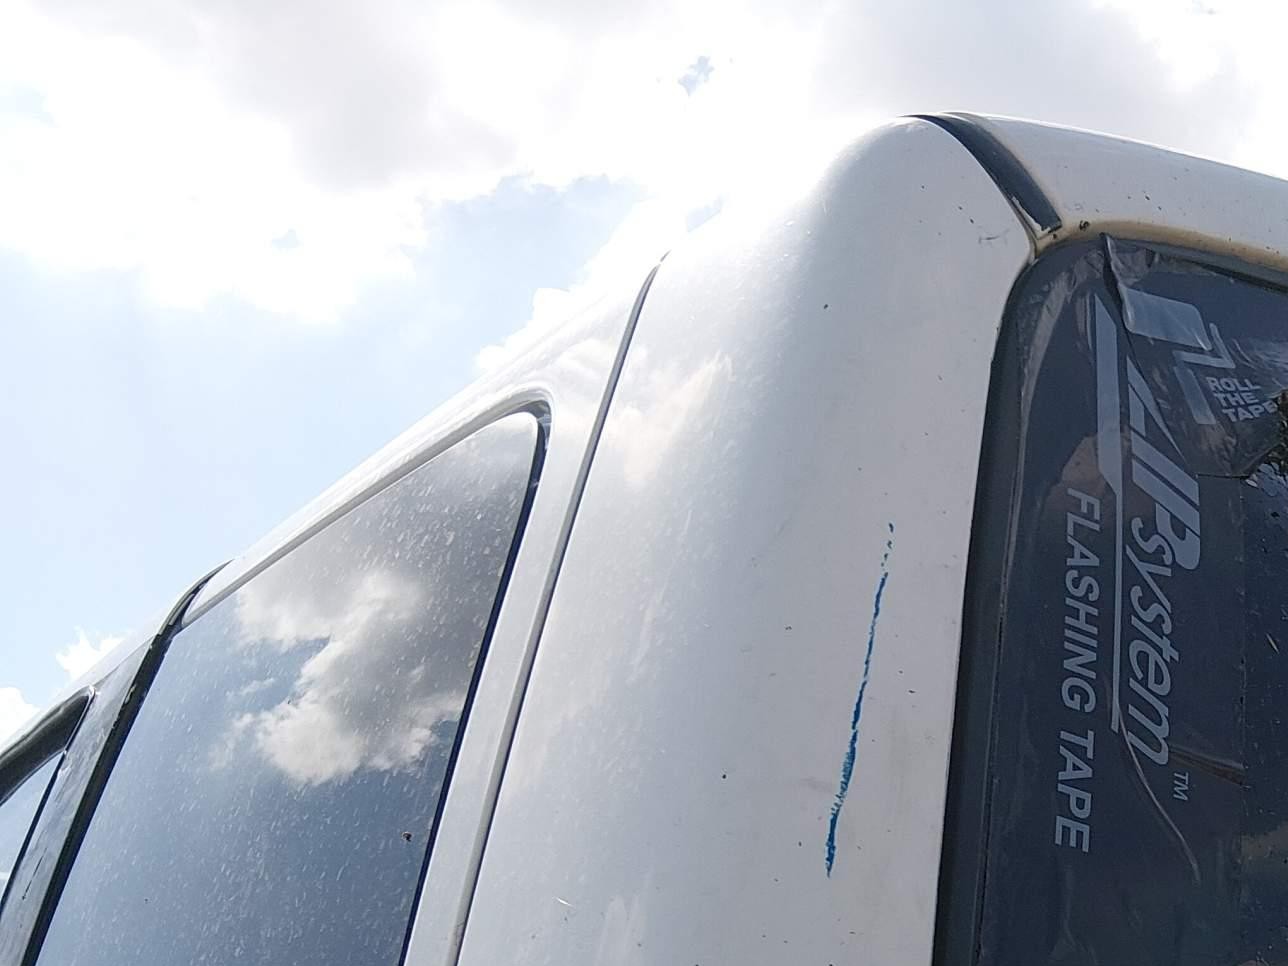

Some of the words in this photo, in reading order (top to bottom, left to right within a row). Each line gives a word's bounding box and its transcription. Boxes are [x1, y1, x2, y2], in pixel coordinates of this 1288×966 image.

[1206, 377, 1260, 391] ROLL
[1213, 392, 1260, 407] THE
[1222, 400, 1278, 422] TAPE
[1061, 488, 1101, 714] FLASHING
[1054, 730, 1094, 853] TAPE
[1173, 771, 1188, 801] TM
